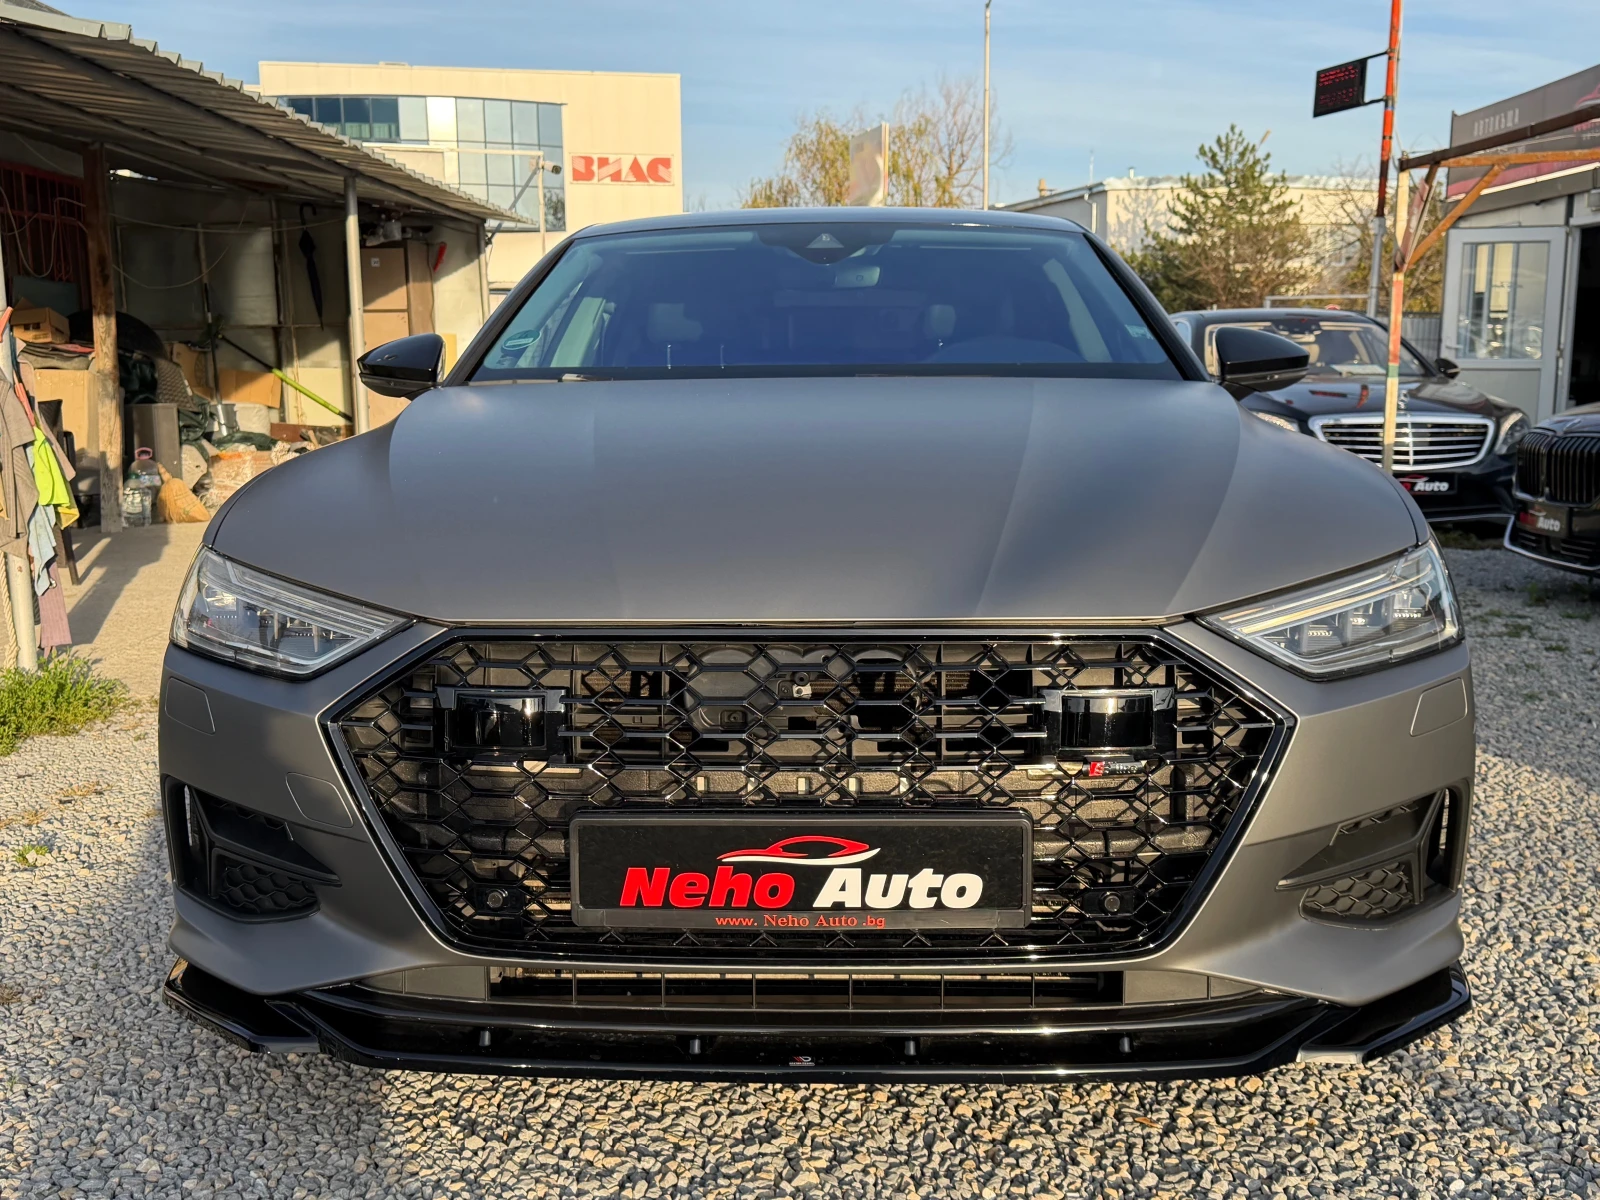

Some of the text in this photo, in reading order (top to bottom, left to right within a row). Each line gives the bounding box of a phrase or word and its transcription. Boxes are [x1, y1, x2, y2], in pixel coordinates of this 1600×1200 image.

[1413, 481, 1450, 492] Auto
[1537, 516, 1561, 532] Auto
[620, 865, 984, 909] Neho Auto
[715, 914, 886, 928] www. Neho Auto .bg
